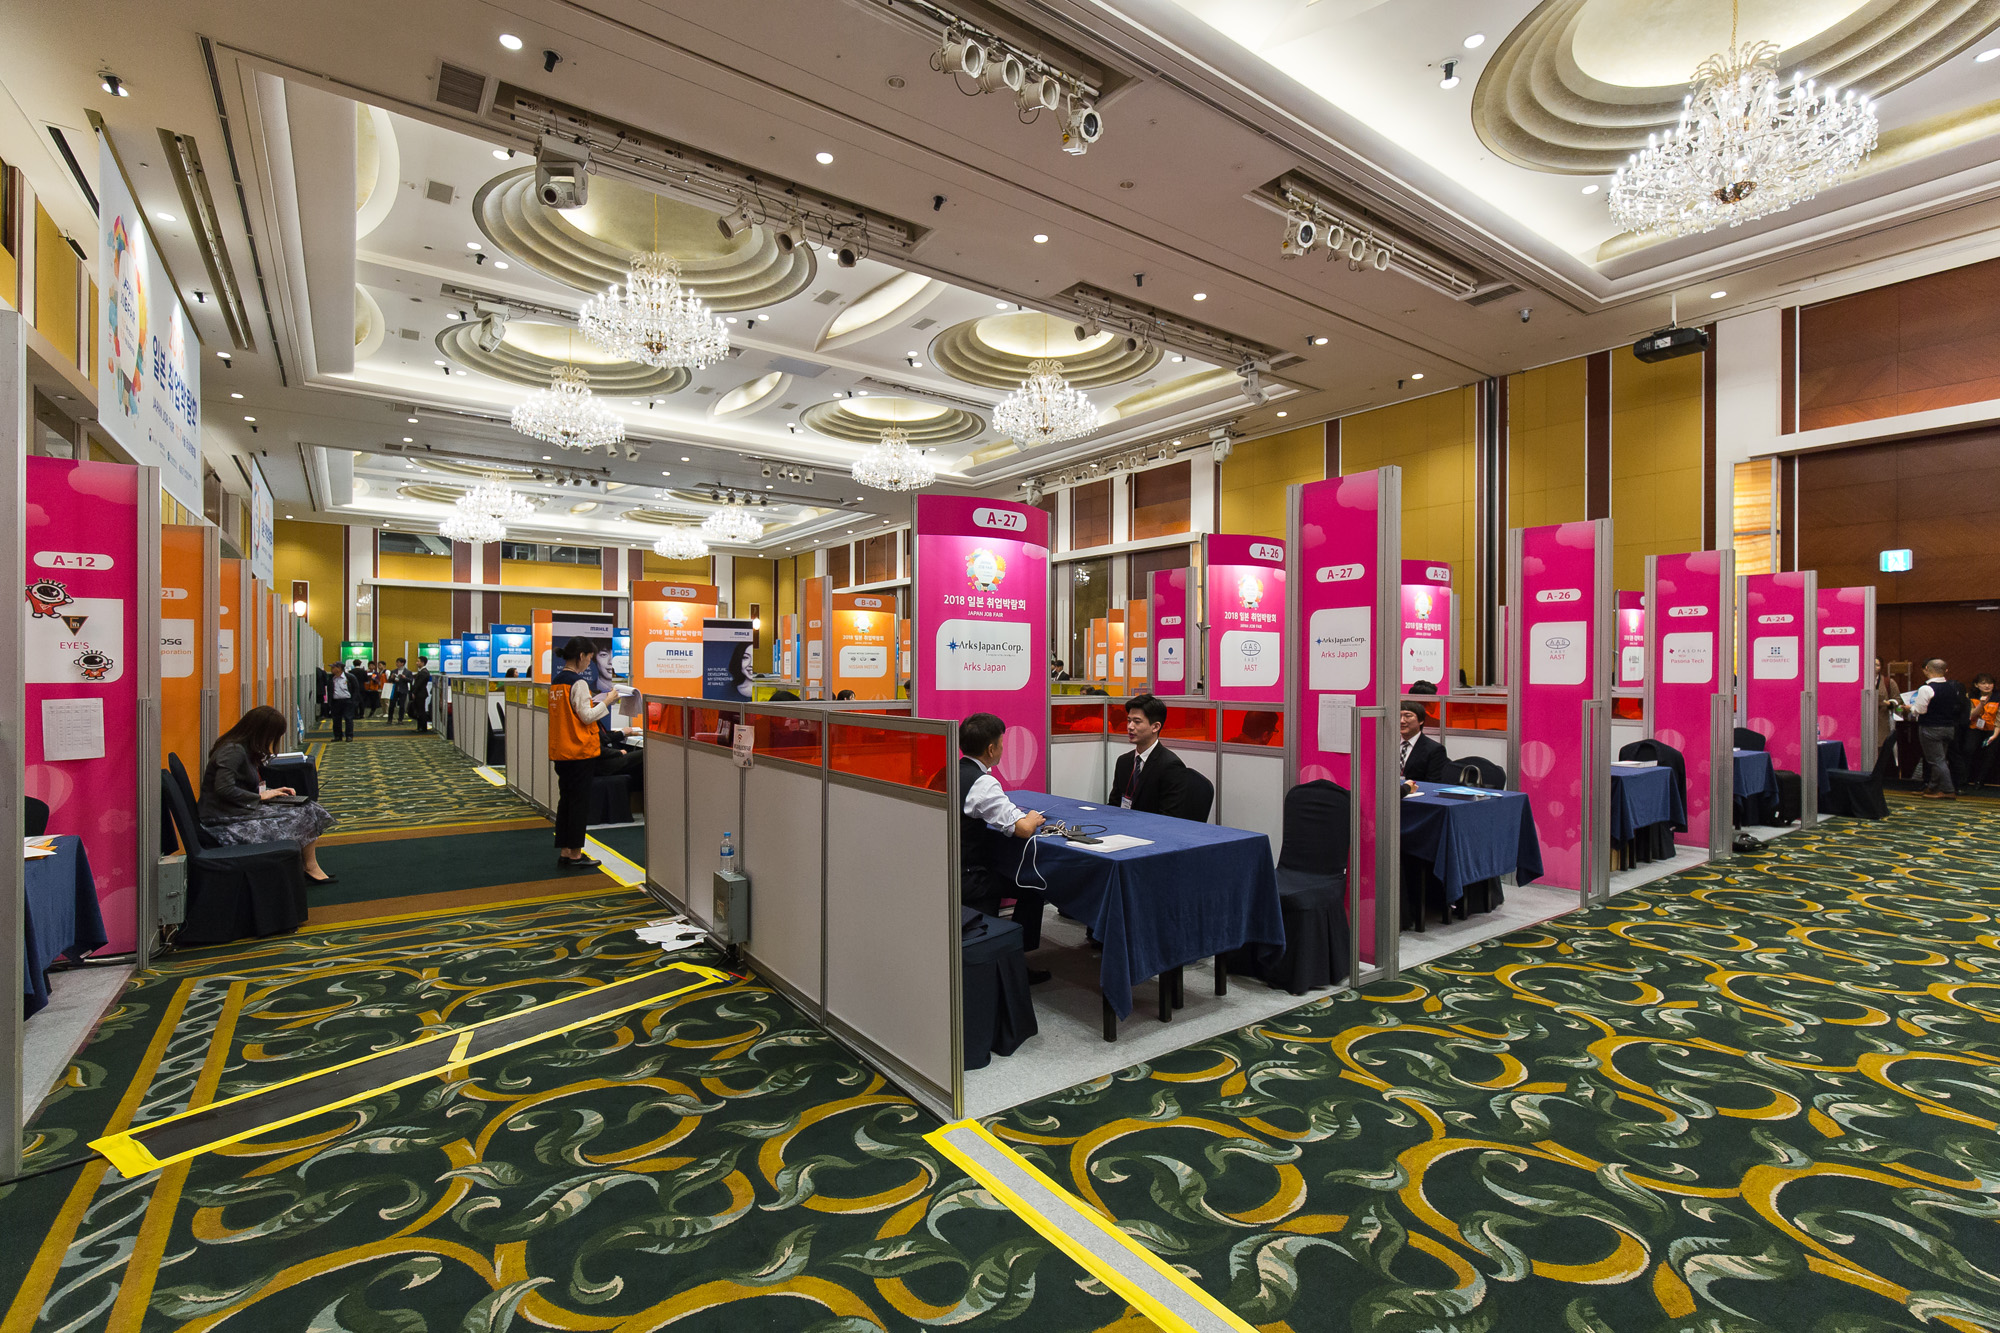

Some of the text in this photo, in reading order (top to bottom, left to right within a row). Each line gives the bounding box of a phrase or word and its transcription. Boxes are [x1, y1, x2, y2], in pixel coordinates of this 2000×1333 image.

[153, 335, 166, 391] 일본
[168, 361, 198, 434] 취업박람회
[987, 512, 1018, 527] A-27
[1259, 547, 1279, 559] A-26
[53, 555, 96, 567] A-12
[1327, 568, 1353, 579] A-27
[1433, 569, 1447, 579] A-25
[670, 588, 690, 596] B-05
[1546, 592, 1571, 600] A-26
[944, 595, 1026, 611] 2018 일본 취업박람회
[1224, 611, 1277, 623] 2018 일본 취업박람회
[1405, 621, 1416, 629] 2018
[649, 628, 662, 636] 2018
[60, 641, 90, 649] EYE'S
[666, 649, 694, 657] MAHLE
[1337, 650, 1358, 659] Japan
[963, 661, 1006, 673] Arks Japan
[1244, 664, 1258, 672] AAST
